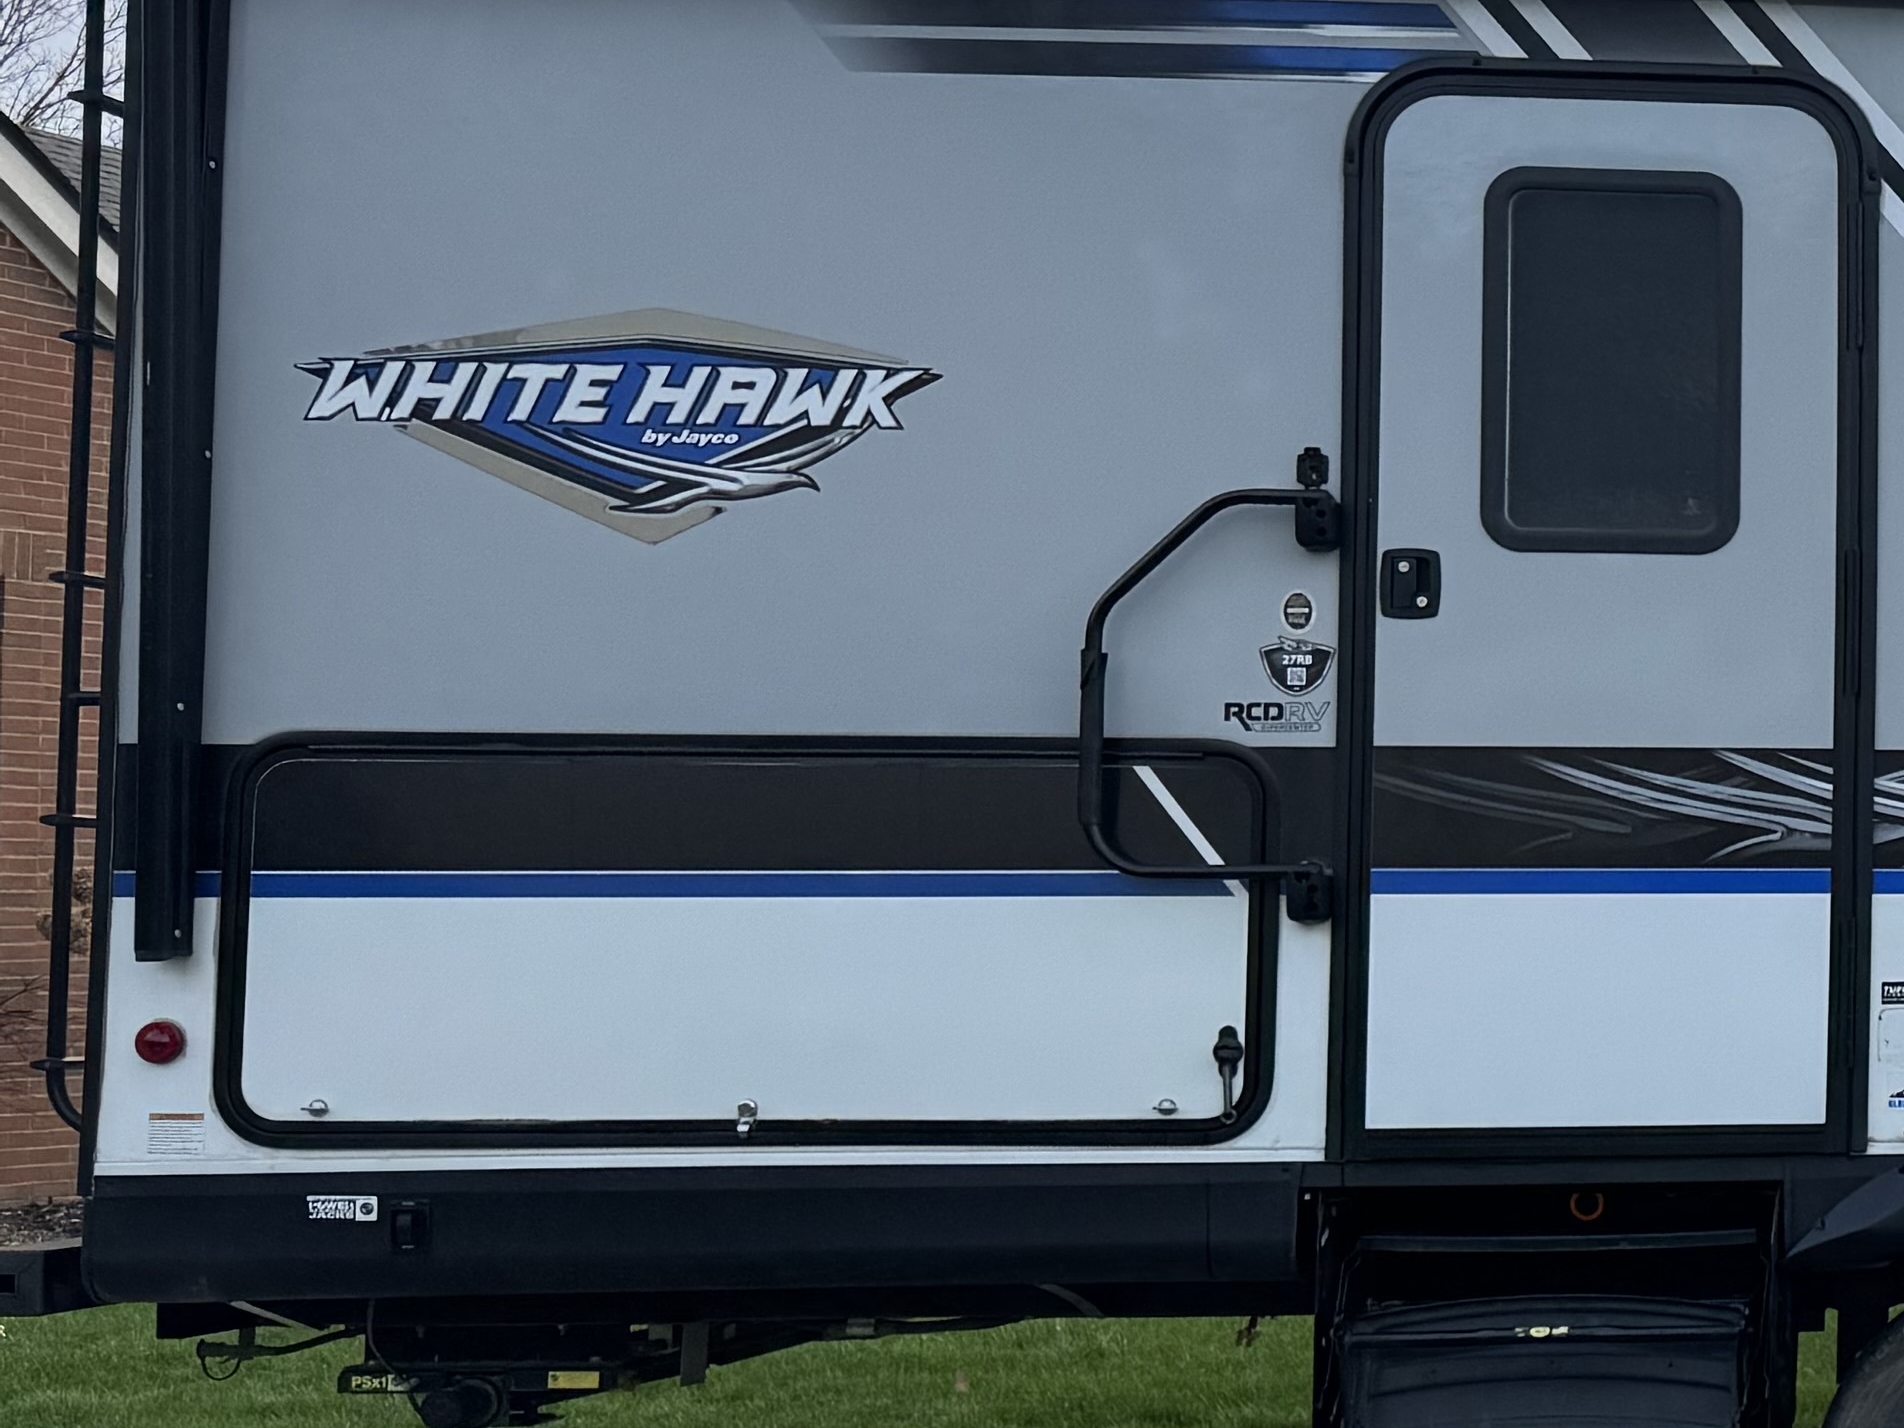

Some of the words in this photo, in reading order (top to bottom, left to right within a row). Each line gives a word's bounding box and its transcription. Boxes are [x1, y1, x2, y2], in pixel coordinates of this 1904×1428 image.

[298, 359, 624, 422] WHITE
[622, 363, 940, 430] HAWK
[641, 429, 671, 446] by
[672, 429, 739, 447] Jayco
[1282, 655, 1312, 665] 27RB
